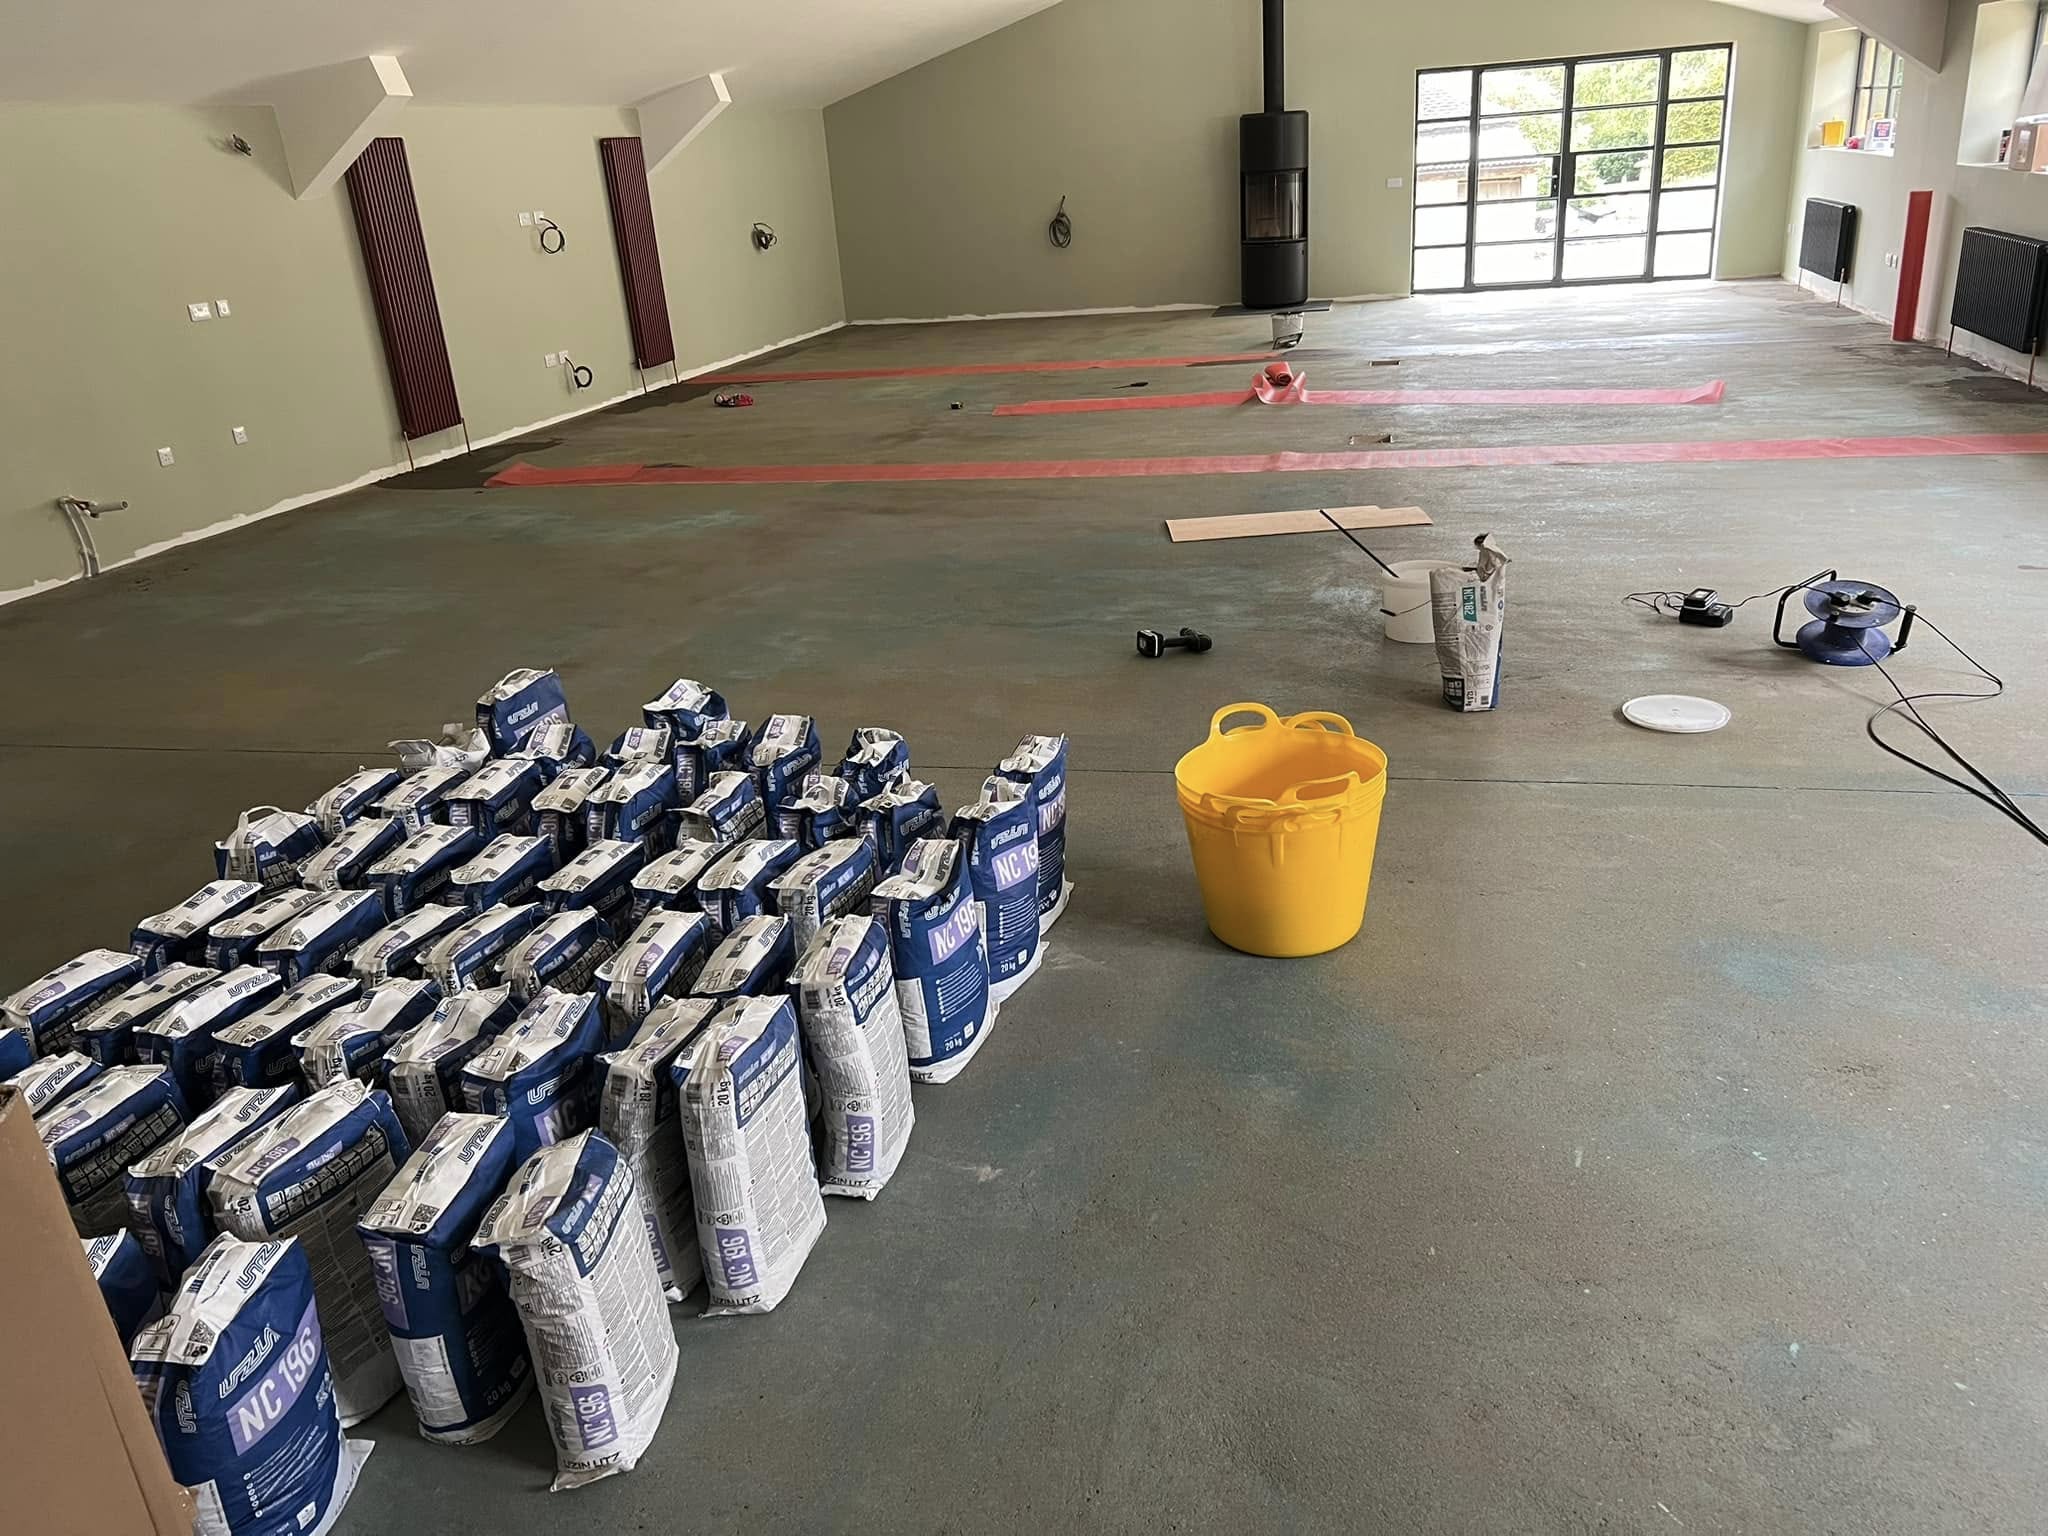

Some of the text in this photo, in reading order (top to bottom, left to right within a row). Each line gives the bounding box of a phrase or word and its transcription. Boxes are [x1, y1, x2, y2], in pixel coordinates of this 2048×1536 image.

[996, 843, 1038, 886] NC 19
[934, 923, 955, 959] NC
[954, 899, 977, 939] 196
[718, 1080, 732, 1107] 20 kg
[850, 1122, 872, 1169] NC 196
[368, 1245, 399, 1306] NC 196
[721, 1235, 754, 1287] NC 196
[238, 1378, 283, 1443] NC
[278, 1327, 316, 1393] 196
[577, 1391, 613, 1447] NC 196
